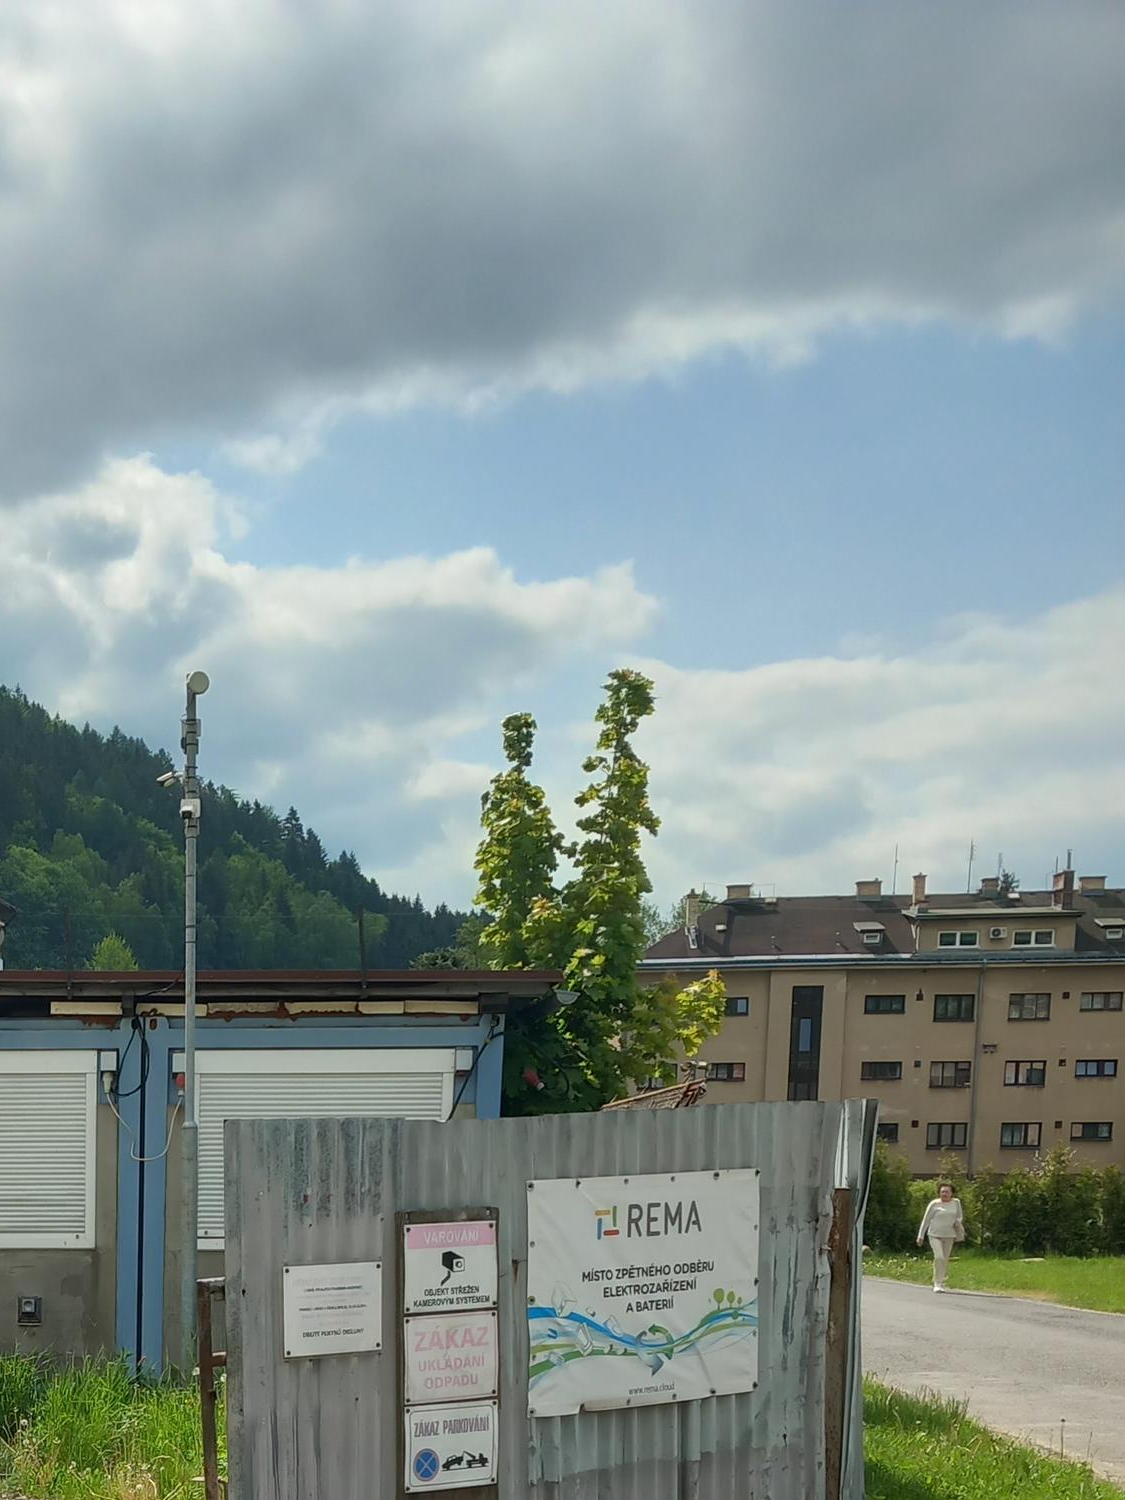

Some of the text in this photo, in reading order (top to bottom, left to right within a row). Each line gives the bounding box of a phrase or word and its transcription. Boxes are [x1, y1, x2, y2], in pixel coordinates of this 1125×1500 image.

[627, 1200, 702, 1239] REMA
[581, 1259, 715, 1283] MÍSTO ZPĚTNÉHO ODBĚRU
[603, 1276, 697, 1298] ELEKTROZAŘÍZENÍ
[626, 1295, 674, 1313] A BATERIÍ
[415, 1325, 489, 1352] ZÁKAZ
[425, 1373, 478, 1389] ODPADU
[414, 1418, 440, 1437] ZÁKAZ
